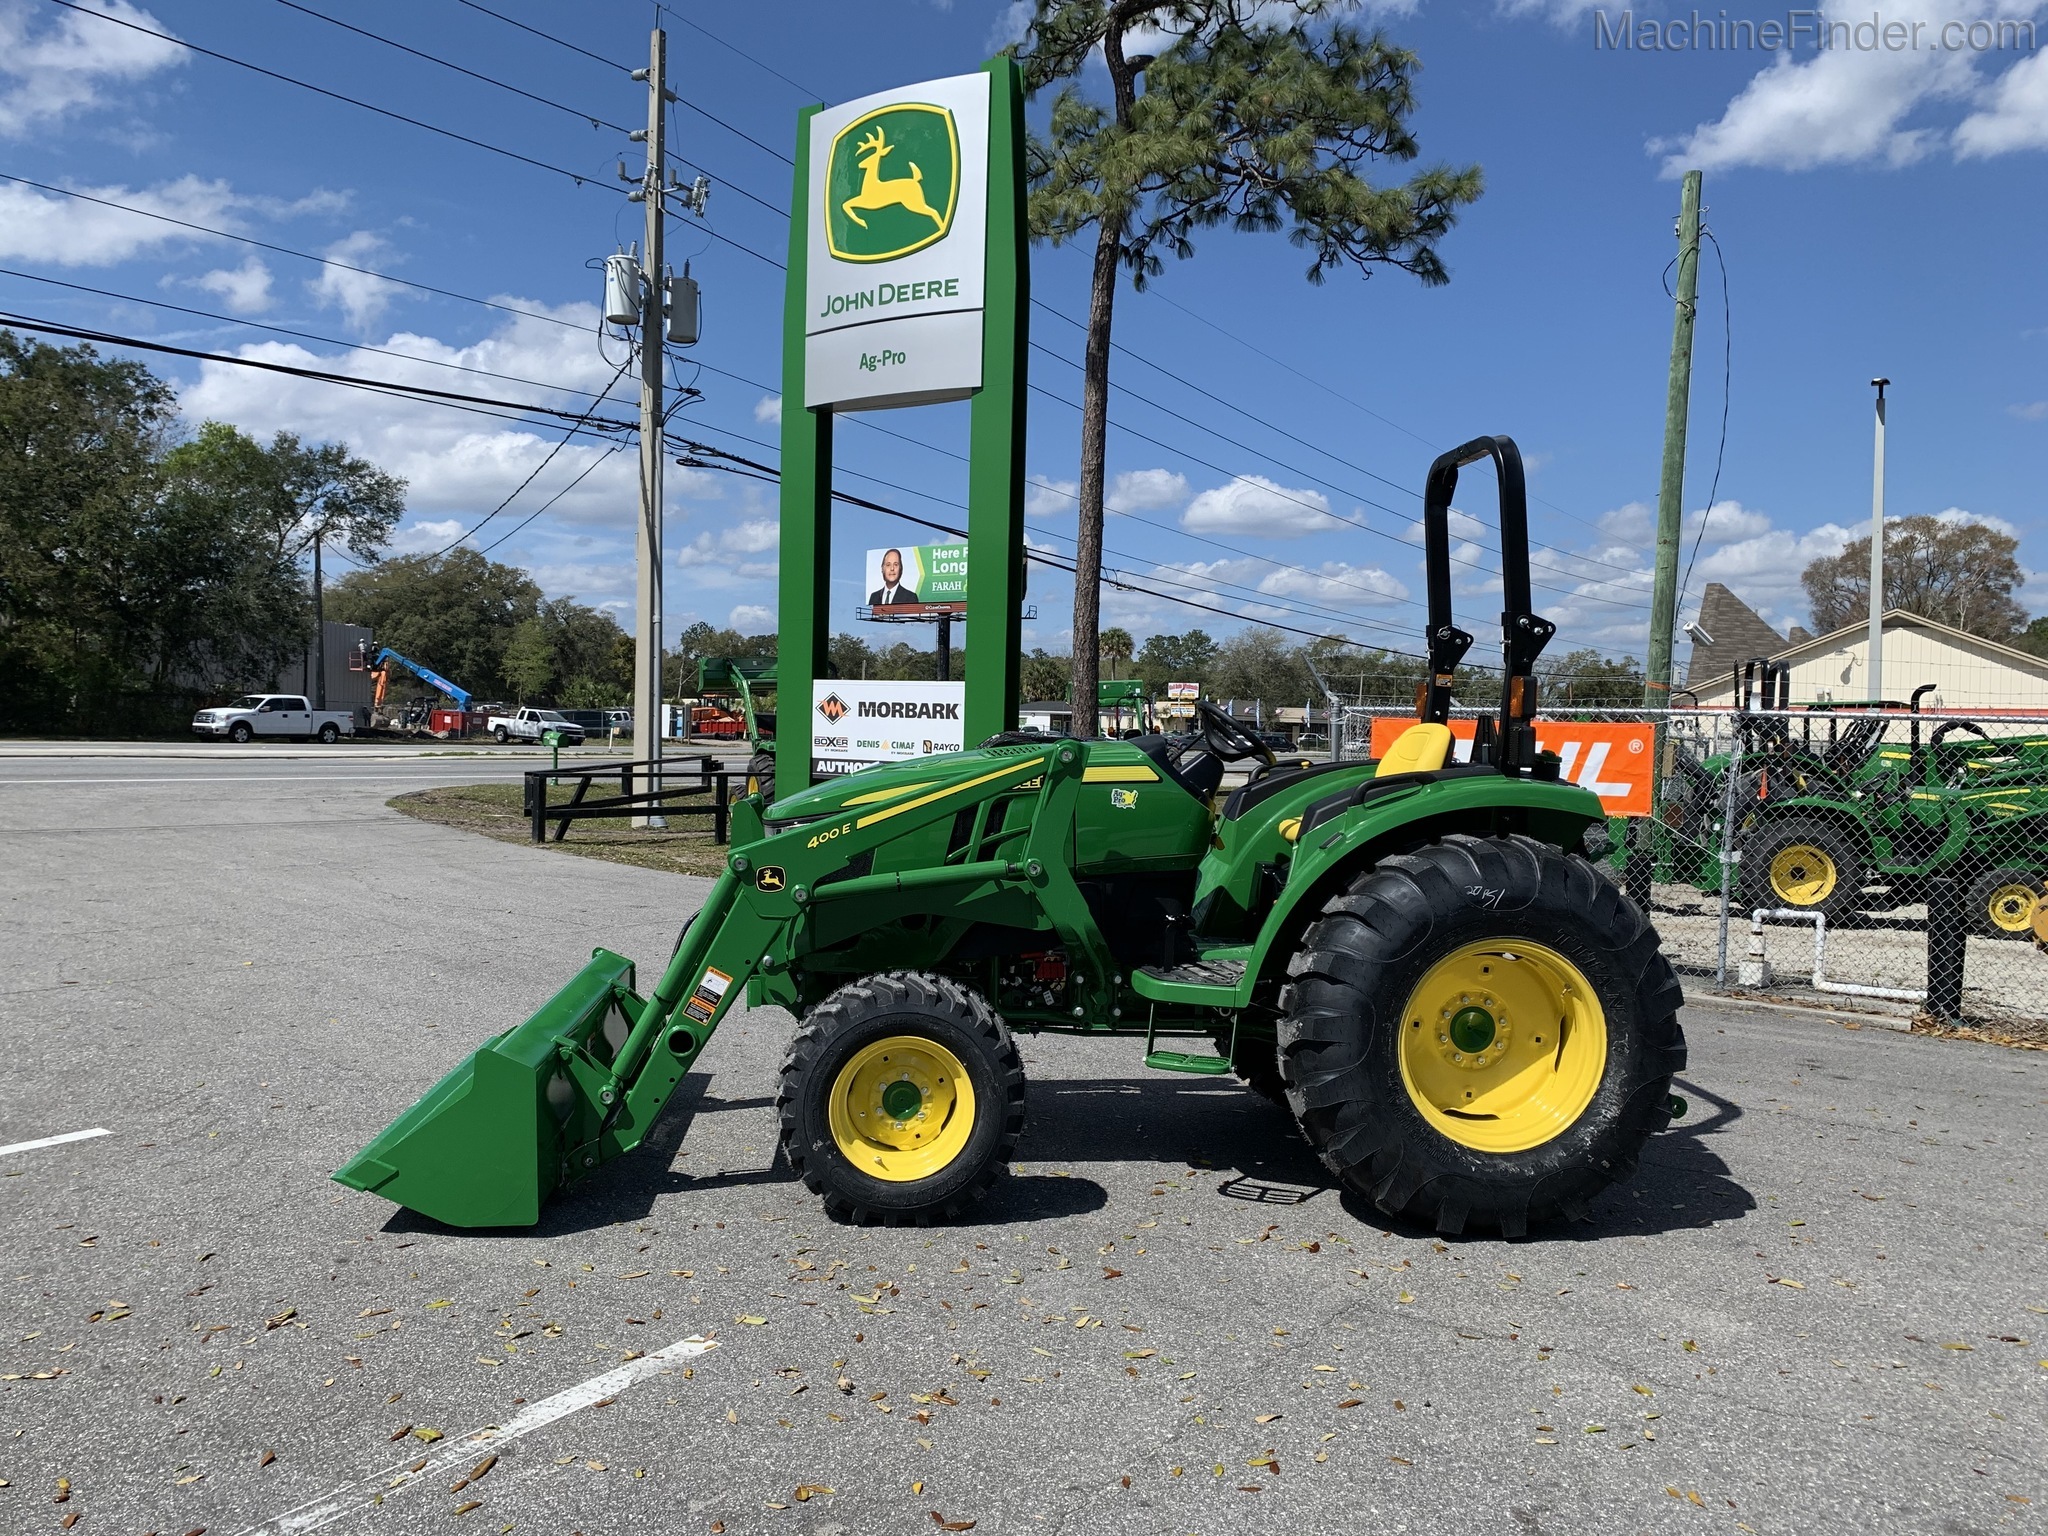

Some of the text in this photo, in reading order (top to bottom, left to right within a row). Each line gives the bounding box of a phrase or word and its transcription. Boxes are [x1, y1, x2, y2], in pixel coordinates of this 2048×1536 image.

[820, 279, 959, 317] JOHN DEERE
[859, 350, 906, 372] Ag-Pro
[932, 548, 960, 560] Here
[932, 560, 967, 575] Long
[932, 581, 961, 591] FARAH
[858, 701, 959, 720] MORBARK
[814, 737, 849, 748] BOXER
[856, 740, 915, 750] DENIS CIMAF
[933, 742, 960, 752] RAYCO
[816, 761, 872, 774] AUTHO
[807, 822, 851, 849] 400 E
